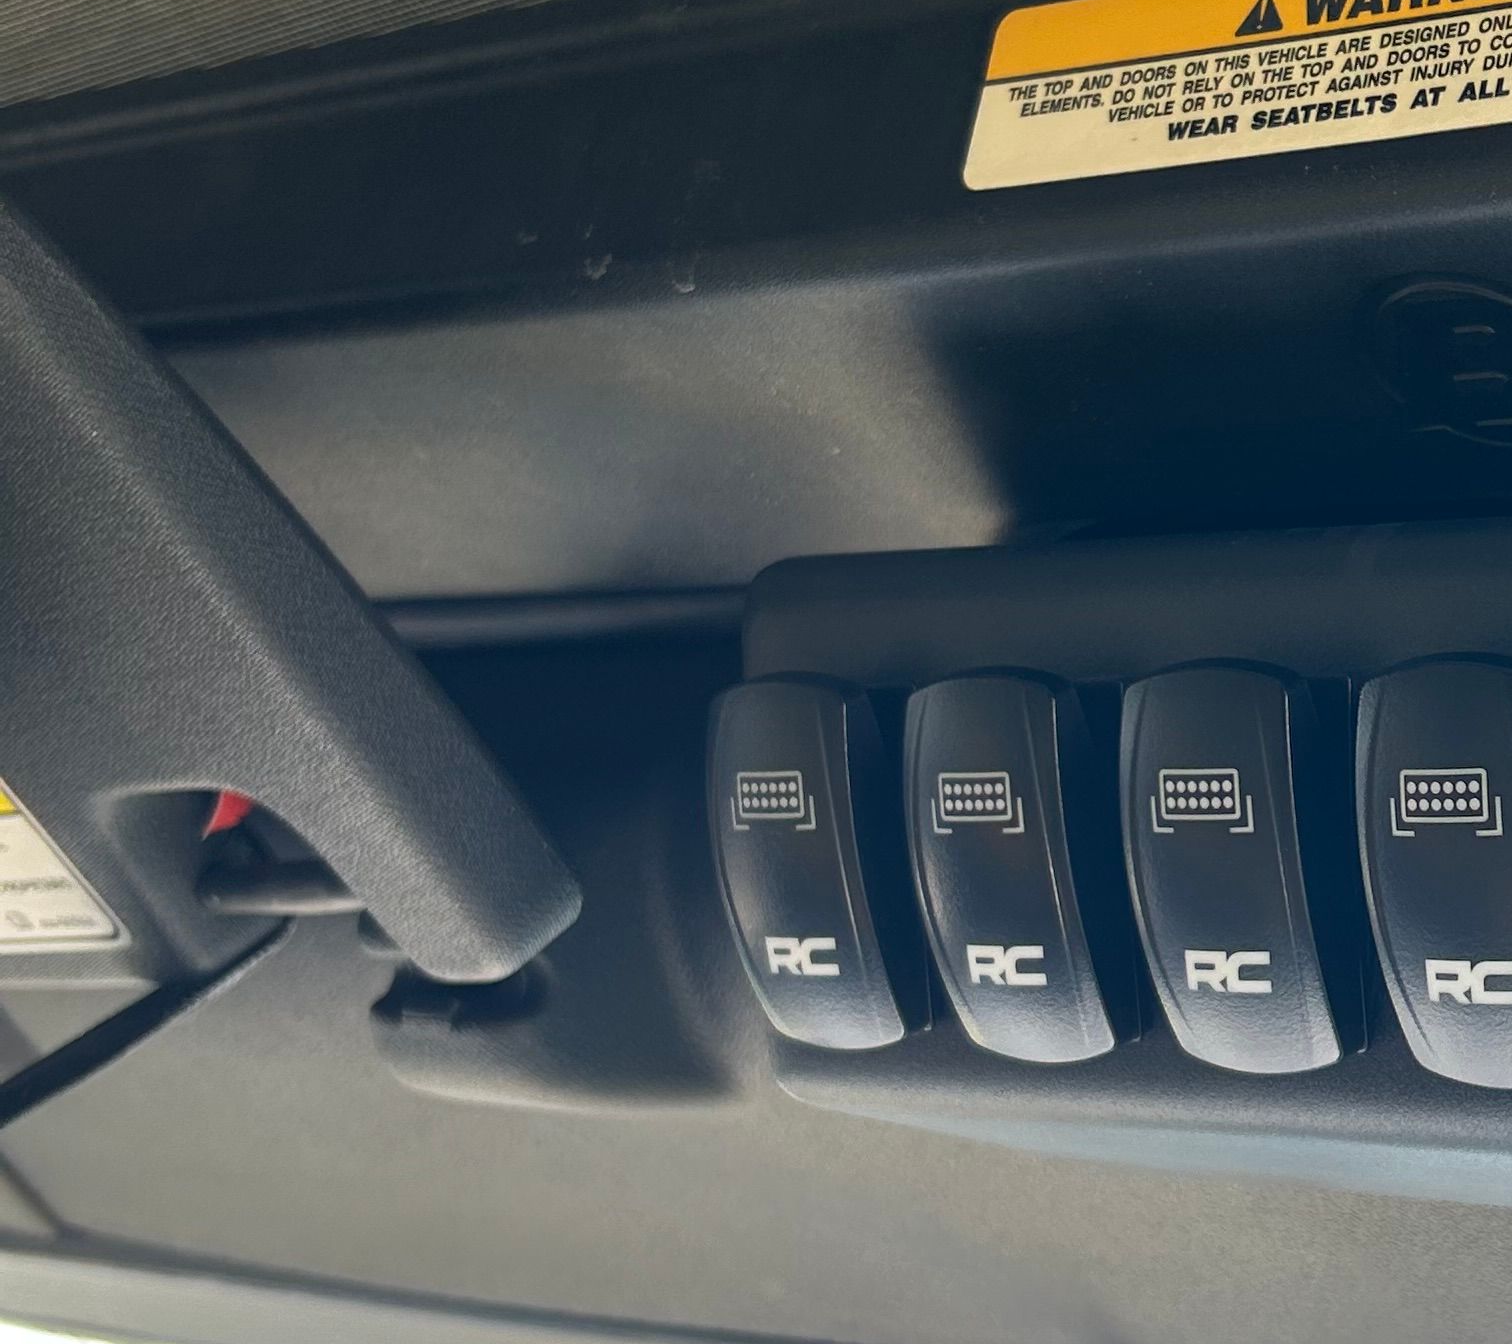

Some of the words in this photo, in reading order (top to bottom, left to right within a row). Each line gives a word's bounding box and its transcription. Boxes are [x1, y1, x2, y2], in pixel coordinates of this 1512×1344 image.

[1008, 84, 1044, 102] THE
[1044, 80, 1074, 97] TOP
[1080, 73, 1113, 91] AND
[1120, 64, 1177, 87] DOORS
[1184, 60, 1208, 77] ON
[1214, 53, 1251, 73] THIS
[1257, 42, 1328, 66] VEHICLE
[1335, 36, 1372, 56] ARE
[1380, 21, 1470, 48] DESIGNED
[1019, 93, 1105, 118] ELEMENTS.
[1112, 88, 1136, 105] DO
[1142, 82, 1176, 102] NOT
[1182, 75, 1224, 96] RELY
[1230, 71, 1255, 89] ON
[1262, 66, 1293, 86] THE
[1301, 60, 1334, 80] TOP
[1342, 52, 1379, 73] AND
[1387, 43, 1451, 66] DOORS
[1458, 38, 1482, 57] TO
[1108, 100, 1175, 123] VEHICLE
[1182, 95, 1206, 113] OR
[1212, 91, 1234, 109] TO
[1241, 80, 1320, 105] PROTECT
[1325, 68, 1404, 95] AGAINST
[1410, 58, 1474, 83] INJURY
[1167, 114, 1239, 141] WEAR
[1250, 93, 1398, 130] SEATBELTS
[1409, 86, 1446, 109] AT
[1457, 77, 1510, 103] ALL
[765, 936, 840, 977] RC
[966, 943, 1048, 986] RC
[1184, 949, 1273, 994] RC
